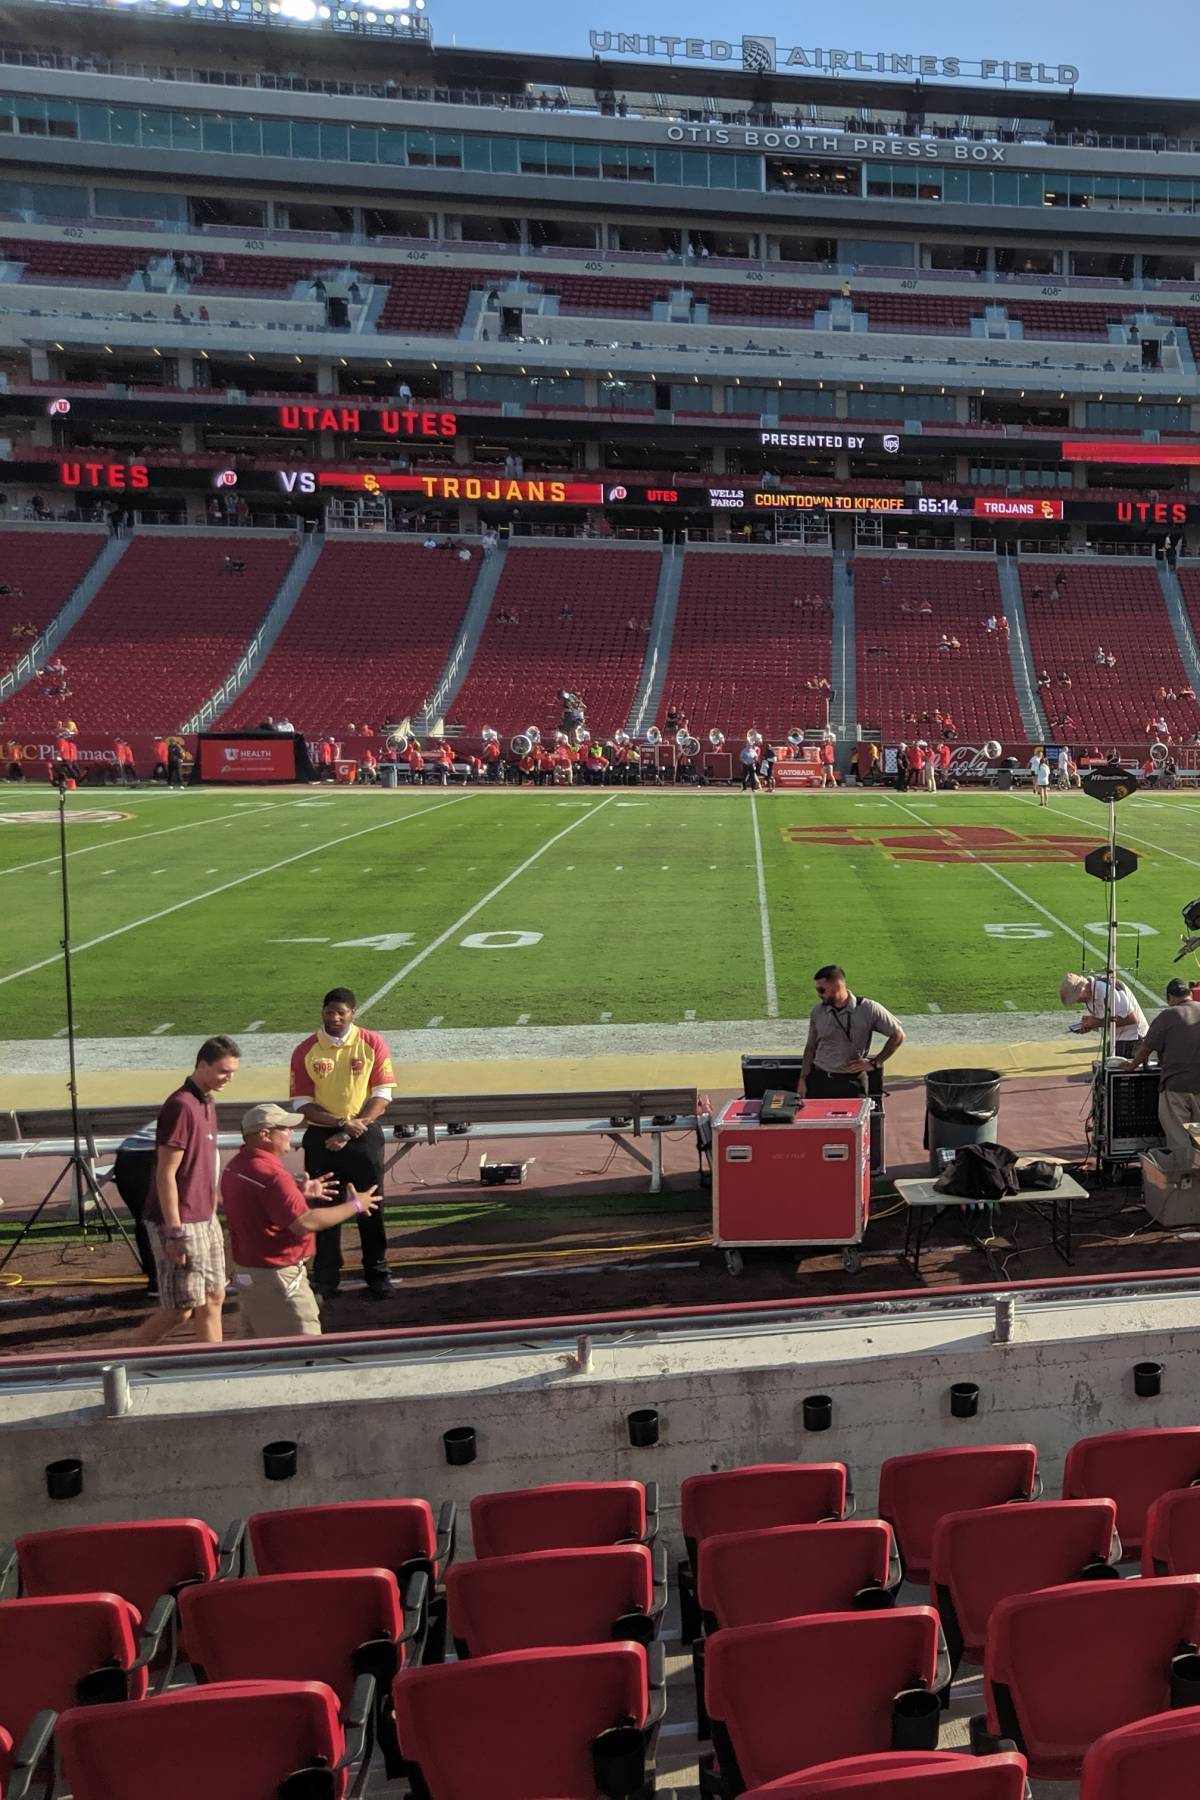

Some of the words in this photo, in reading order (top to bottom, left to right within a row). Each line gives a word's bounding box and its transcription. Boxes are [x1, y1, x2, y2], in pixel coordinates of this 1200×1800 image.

[589, 30, 732, 61] UNITED
[786, 46, 961, 78] AIRLINES
[980, 59, 1080, 85] FIELD
[666, 125, 731, 146] OTIS
[744, 130, 839, 153] BOOTH
[853, 138, 939, 159] PRESS
[954, 144, 1008, 162] BOX
[63, 227, 84, 239] 402
[244, 240, 265, 250] 403
[406, 250, 426, 261] 404
[584, 261, 604, 272] 405
[745, 271, 763, 282] 406
[900, 279, 917, 290] 407
[1040, 286, 1060, 297] 408
[281, 406, 360, 433] UTAH
[381, 410, 458, 436] UTES
[761, 432, 844, 449] PRESENTED
[848, 435, 865, 449] BY
[63, 463, 149, 488] UTES
[281, 471, 317, 494] VS
[421, 476, 566, 502] TROJANS
[647, 489, 678, 502] UTES
[709, 489, 744, 499] WELLS
[711, 498, 744, 508] FARGO
[755, 493, 833, 508] COUNTDOWN
[836, 497, 852, 508] TO
[854, 498, 905, 511] KICKOFF
[918, 498, 959, 514] 65:14
[983, 501, 1034, 515] TROJANS
[1117, 502, 1186, 524] UTES
[240, 750, 272, 758] HEALTH
[983, 921, 1160, 940] 50
[330, 930, 545, 951] 40
